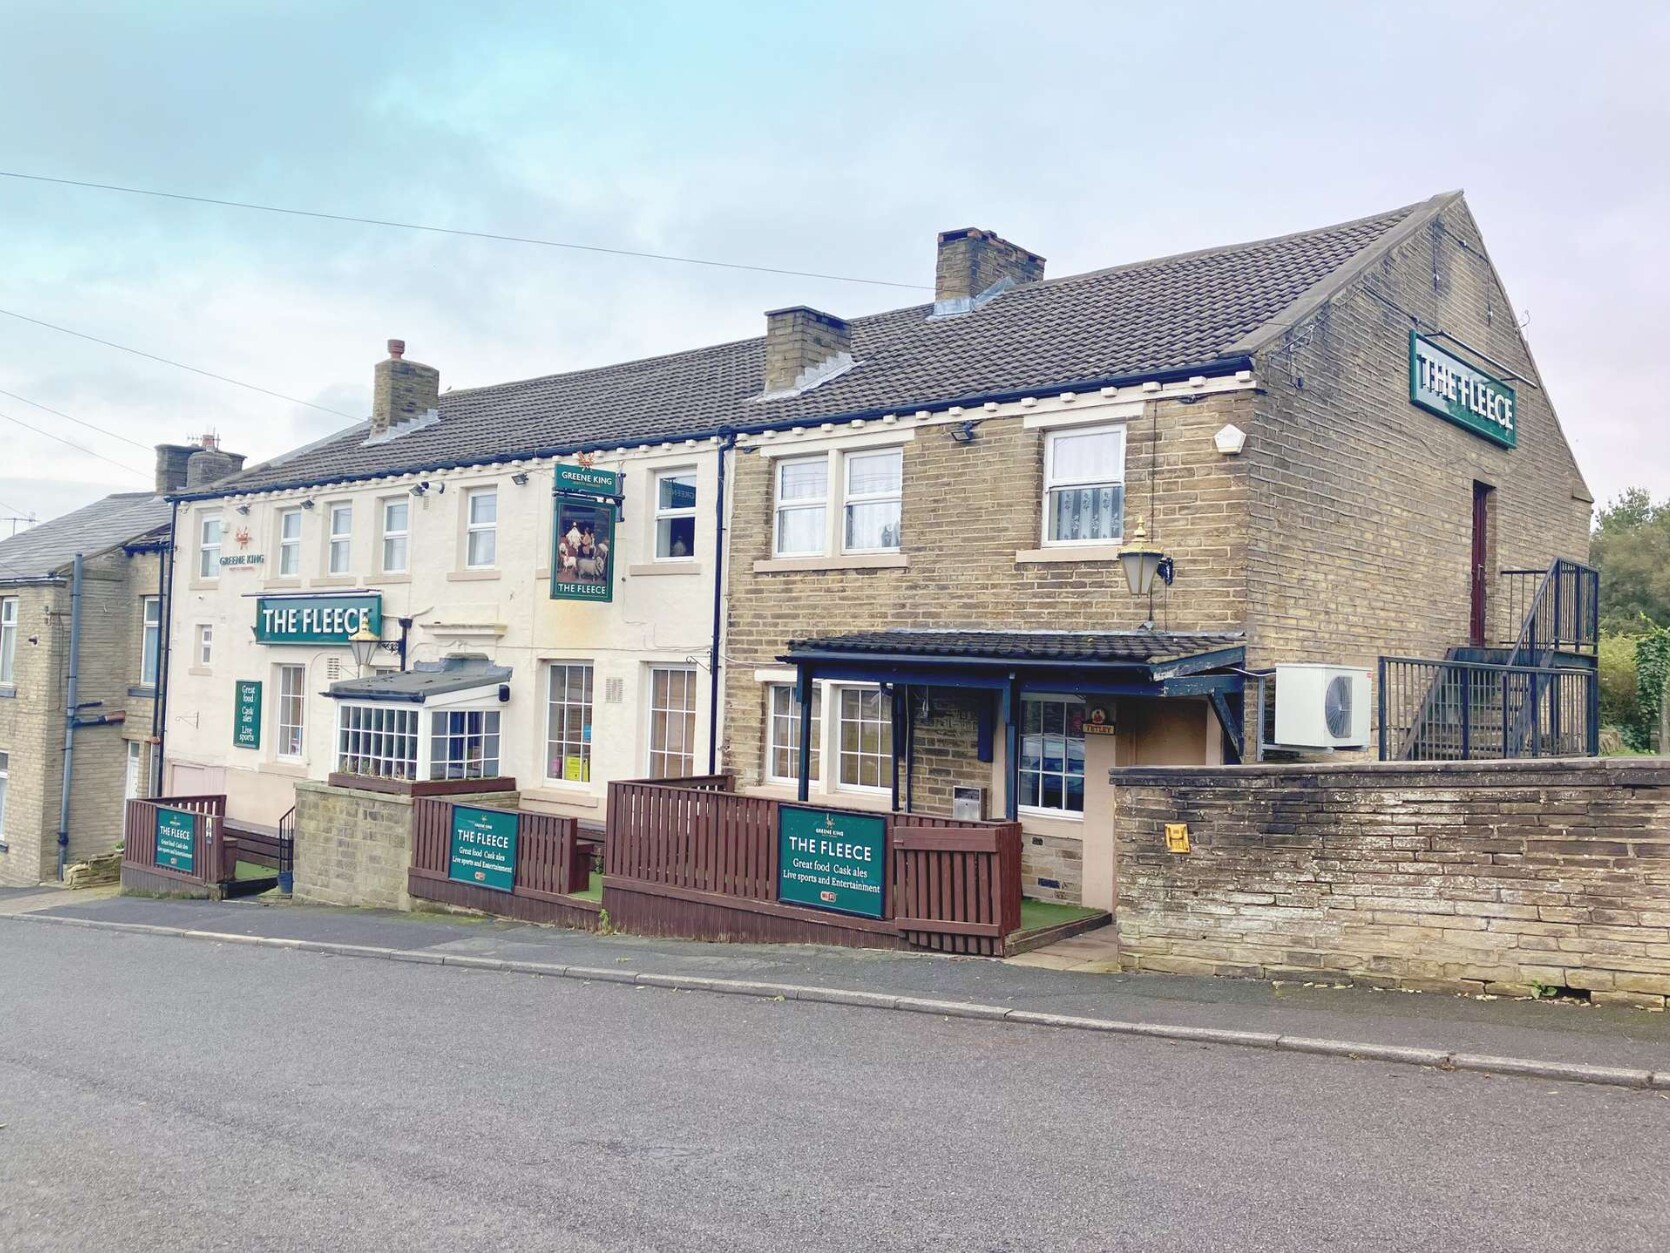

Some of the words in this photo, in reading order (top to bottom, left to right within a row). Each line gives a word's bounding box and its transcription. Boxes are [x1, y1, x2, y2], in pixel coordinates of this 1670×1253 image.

[1421, 352, 1456, 402] THE
[1459, 375, 1513, 430] FLEECE
[561, 471, 592, 483] GREENE
[593, 476, 612, 486] KING
[558, 583, 575, 593] THE
[577, 585, 606, 594] FLEECE
[262, 608, 297, 633] THE
[160, 825, 170, 837] THE
[171, 828, 190, 840] FLEECE
[457, 829, 475, 843] THE
[476, 832, 509, 849] FLEECE
[459, 846, 472, 855] Great
[472, 848, 482, 857] food
[789, 836, 816, 854] THE
[821, 840, 872, 862] FLEECE
[792, 858, 813, 870] Great
[814, 860, 830, 872] food
[833, 864, 851, 876] Cask
[852, 867, 868, 878] ales
[783, 869, 797, 879] Live
[797, 873, 817, 883] sports
[817, 876, 830, 885] and
[831, 877, 881, 894] Entertainment
